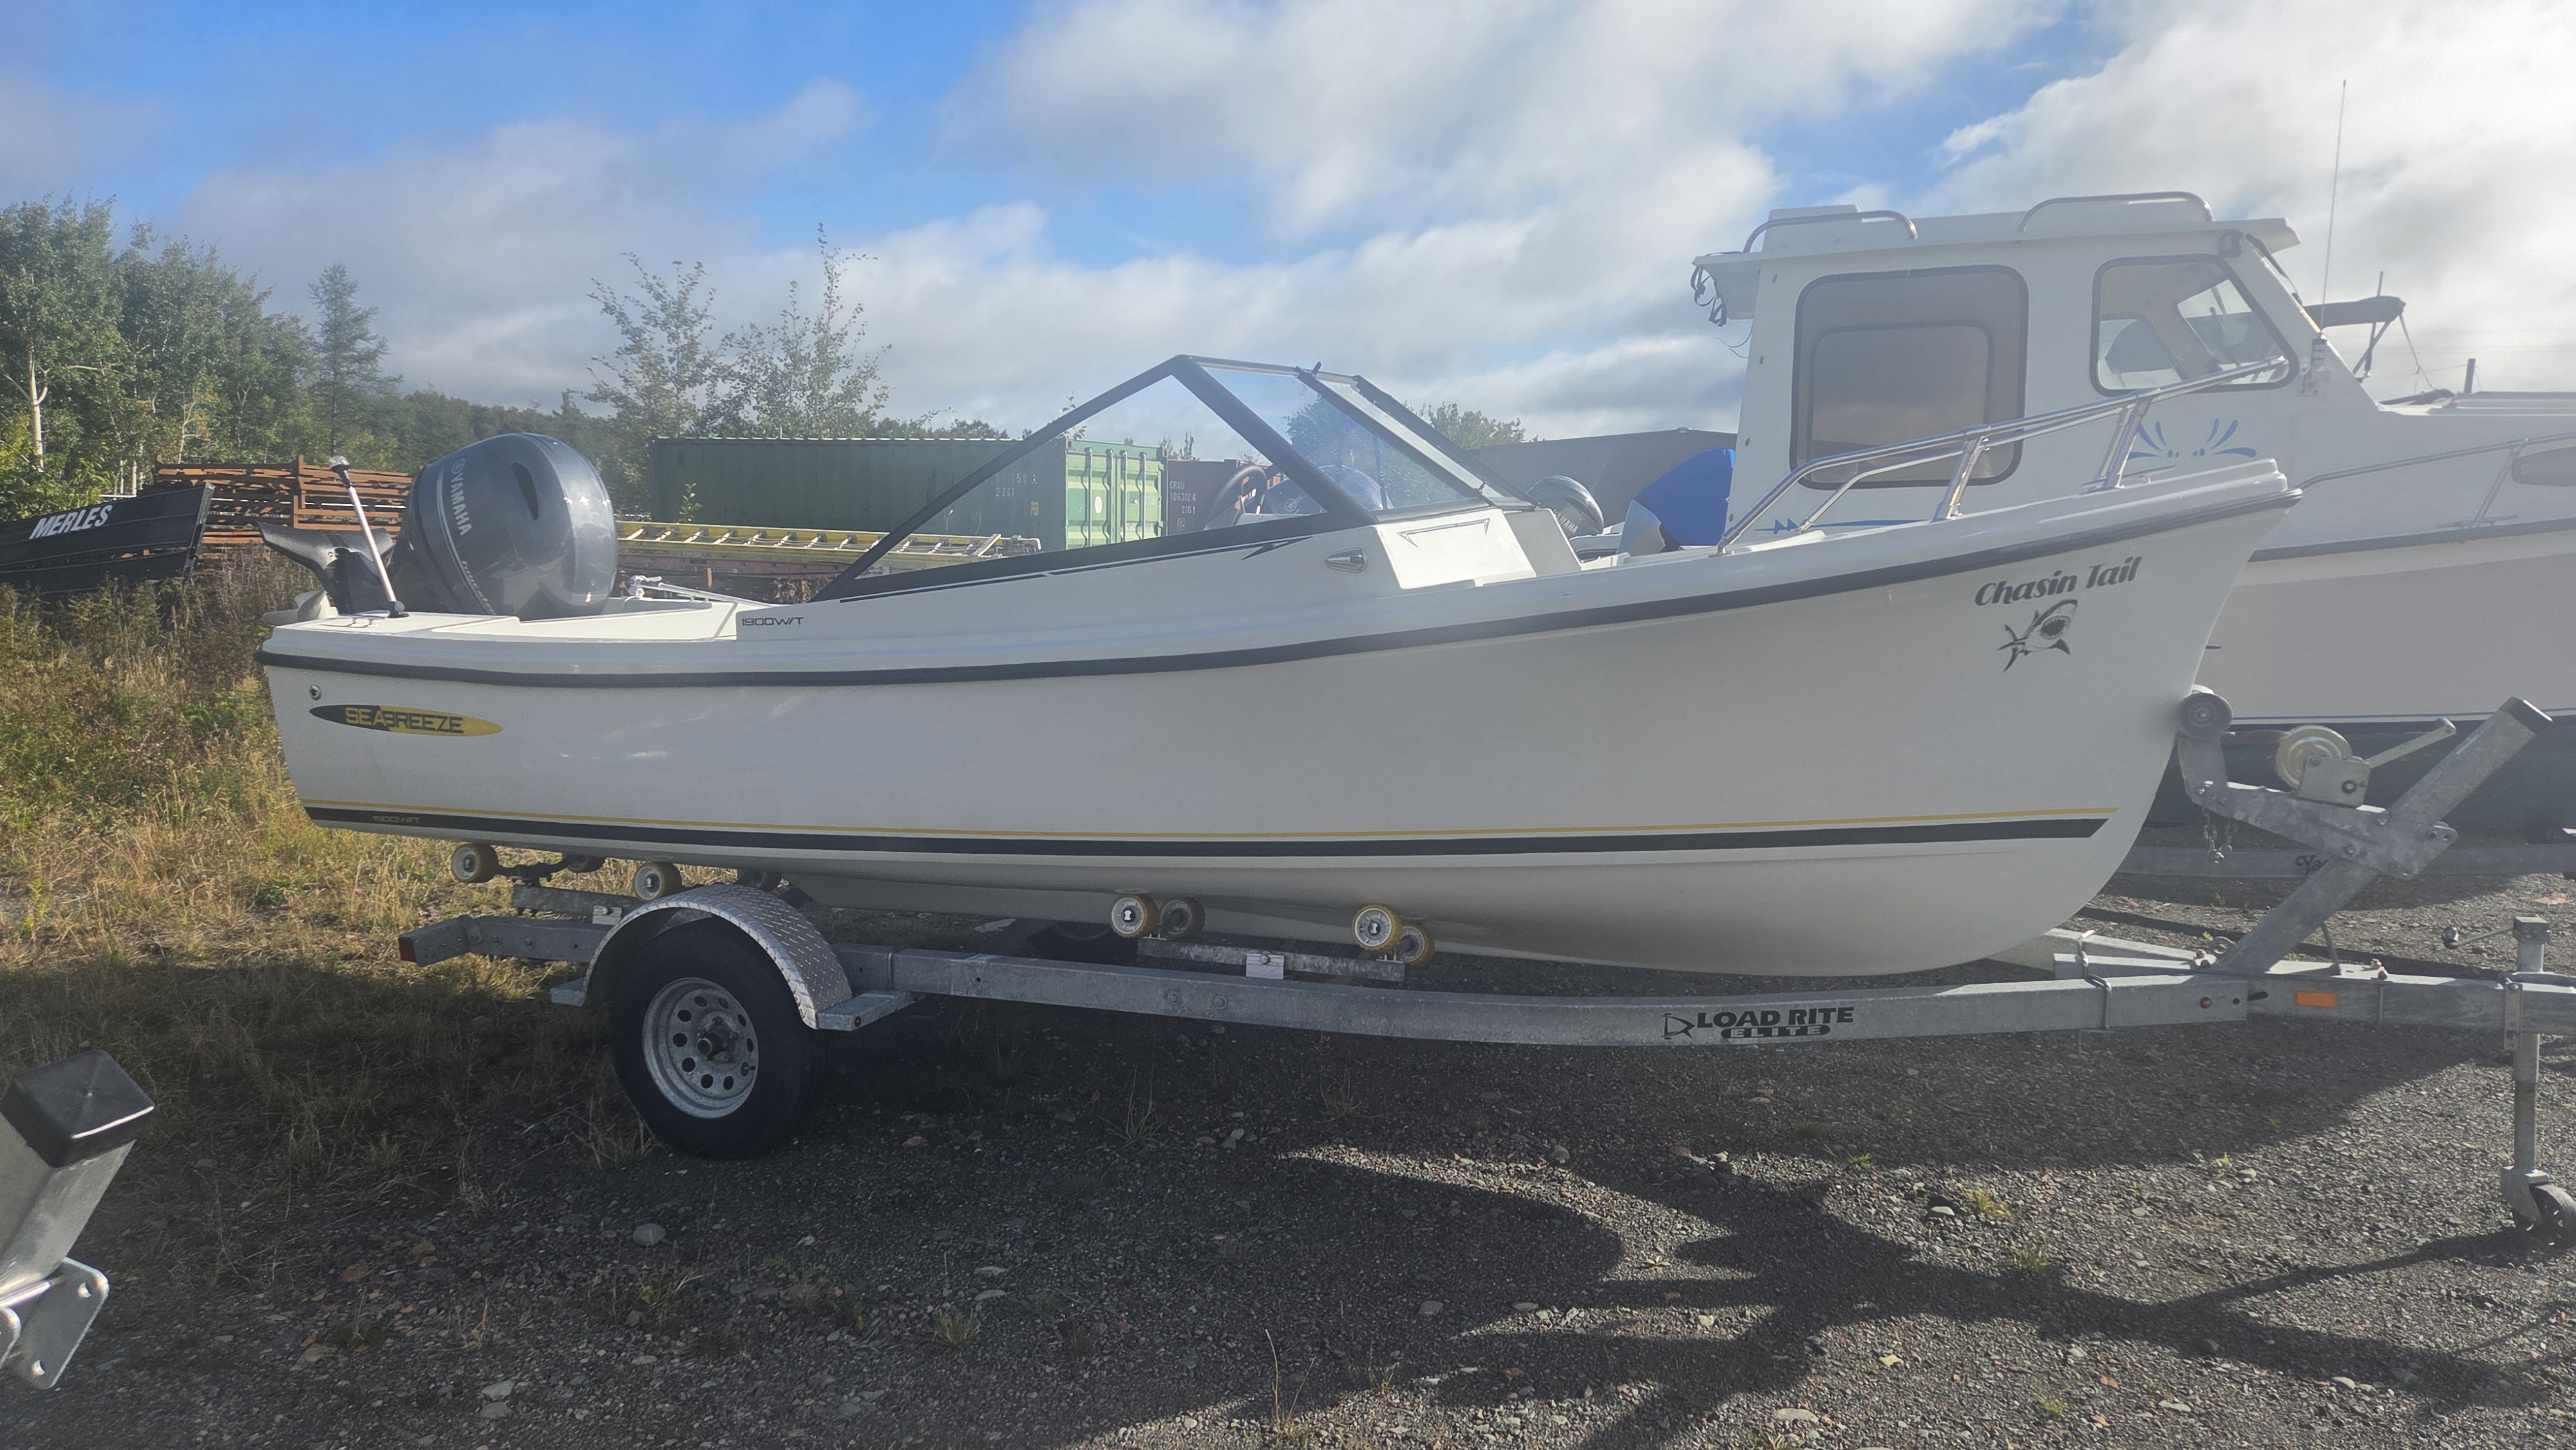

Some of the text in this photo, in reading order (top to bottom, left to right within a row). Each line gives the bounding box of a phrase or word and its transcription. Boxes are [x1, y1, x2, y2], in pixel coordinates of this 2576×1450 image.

[450, 473, 472, 536] YAMAHA
[28, 504, 113, 540] MERLES
[1975, 556, 2143, 606] Chasin Tail
[742, 617, 804, 626] 1900W/T
[345, 707, 464, 734] SEABREEZE
[1697, 1006, 1855, 1028] LOAD RITE
[1730, 1026, 1822, 1037] ELITE
